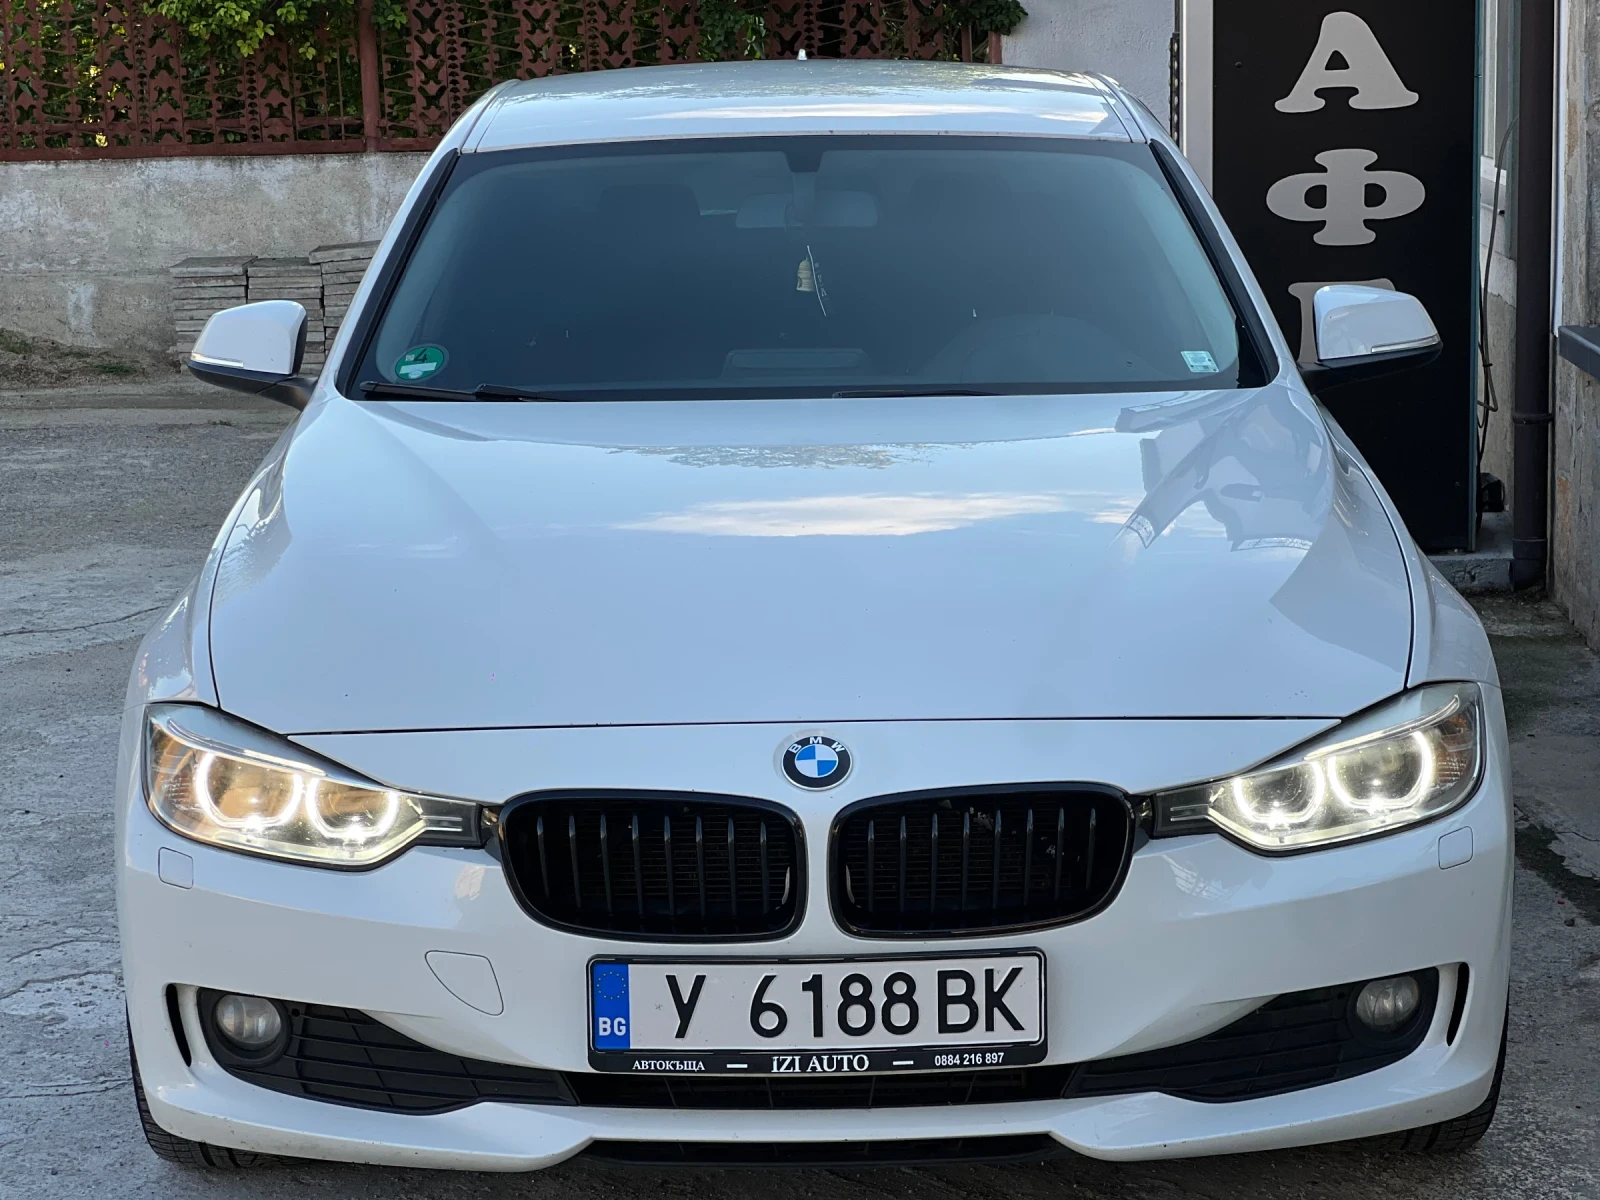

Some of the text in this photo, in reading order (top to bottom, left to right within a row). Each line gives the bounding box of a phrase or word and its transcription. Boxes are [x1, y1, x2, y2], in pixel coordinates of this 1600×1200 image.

[413, 348, 427, 363] 4
[788, 736, 845, 753] BMW
[749, 971, 919, 1038] 6188
[598, 1017, 627, 1036] BG
[632, 1052, 1005, 1073] АВТОКЪЩА IZI AUTO 0884 216 897
